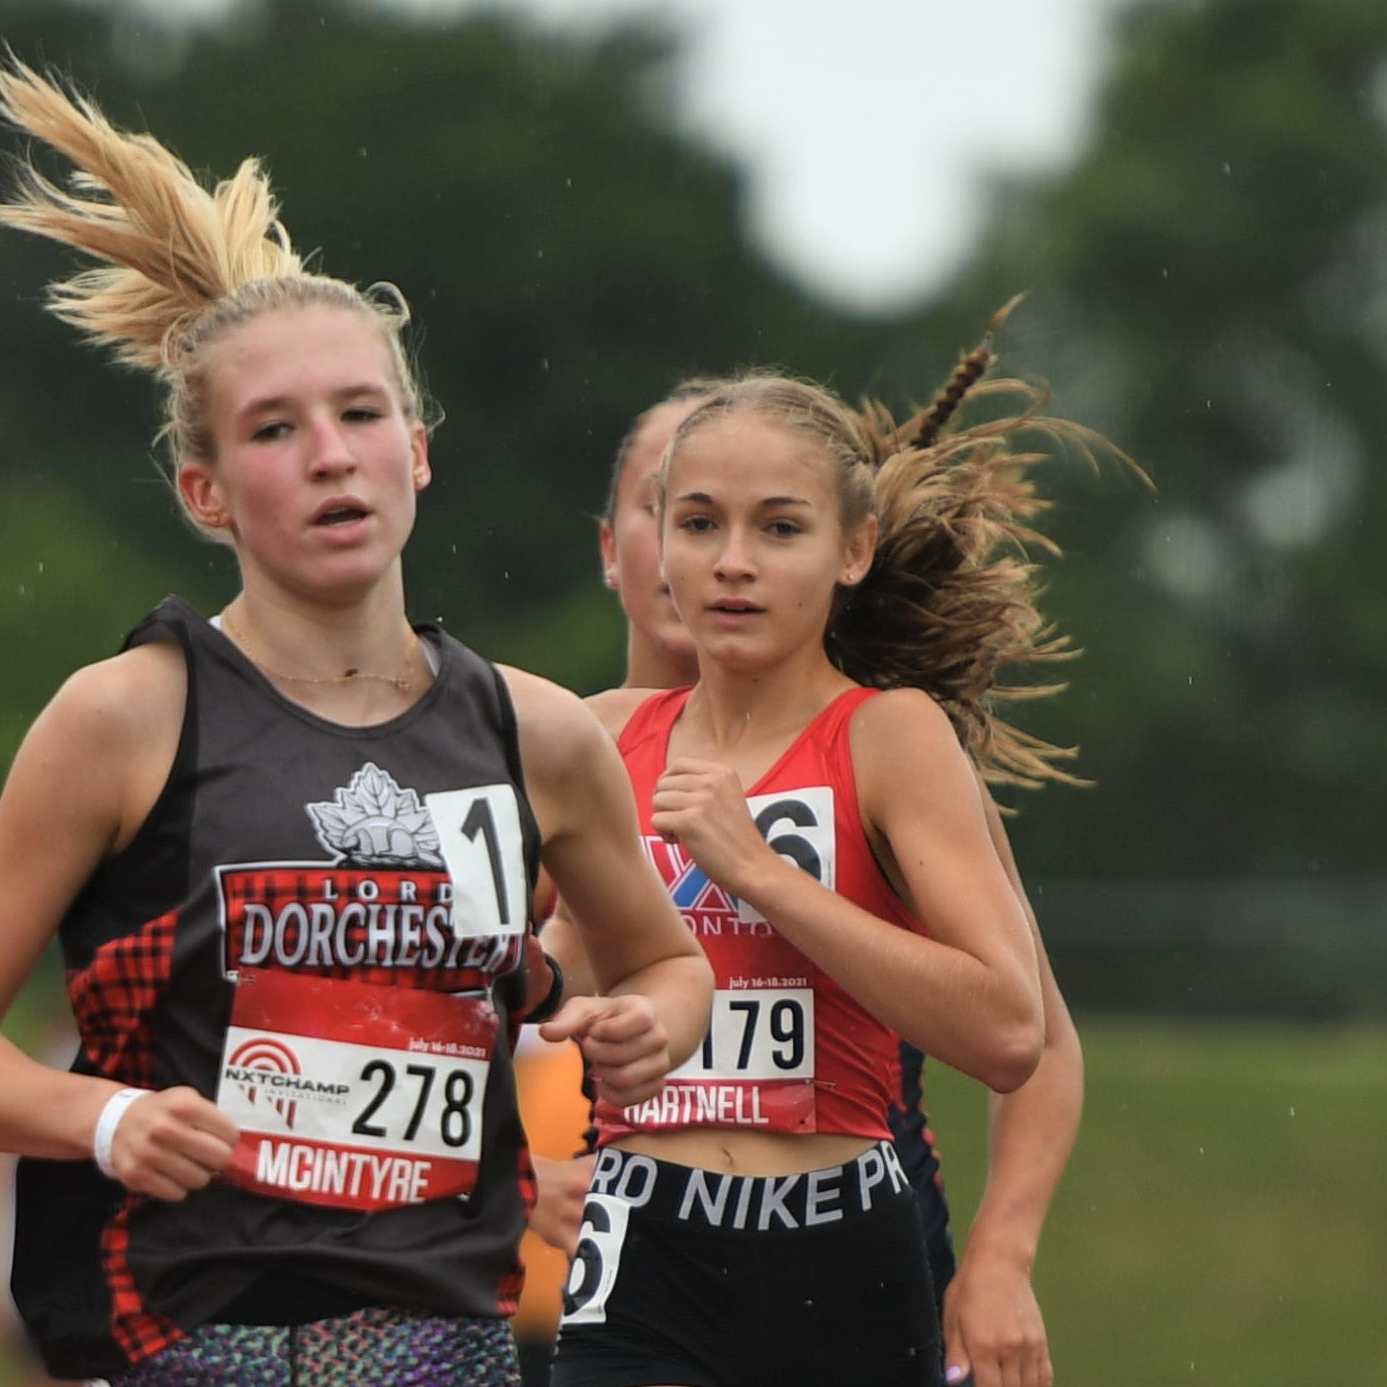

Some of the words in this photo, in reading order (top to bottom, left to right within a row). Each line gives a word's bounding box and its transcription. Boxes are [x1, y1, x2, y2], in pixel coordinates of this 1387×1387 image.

[324, 879, 453, 902] LORD
[461, 797, 510, 925] 1
[751, 977, 808, 987] 16-18.2021
[225, 1068, 350, 1095] NXTCHAMP
[352, 1059, 475, 1147] 278
[256, 1140, 431, 1203] MCINTYRE
[590, 1147, 658, 1207] RO
[678, 1167, 844, 1230] NIKE
[857, 1140, 909, 1211] PR
